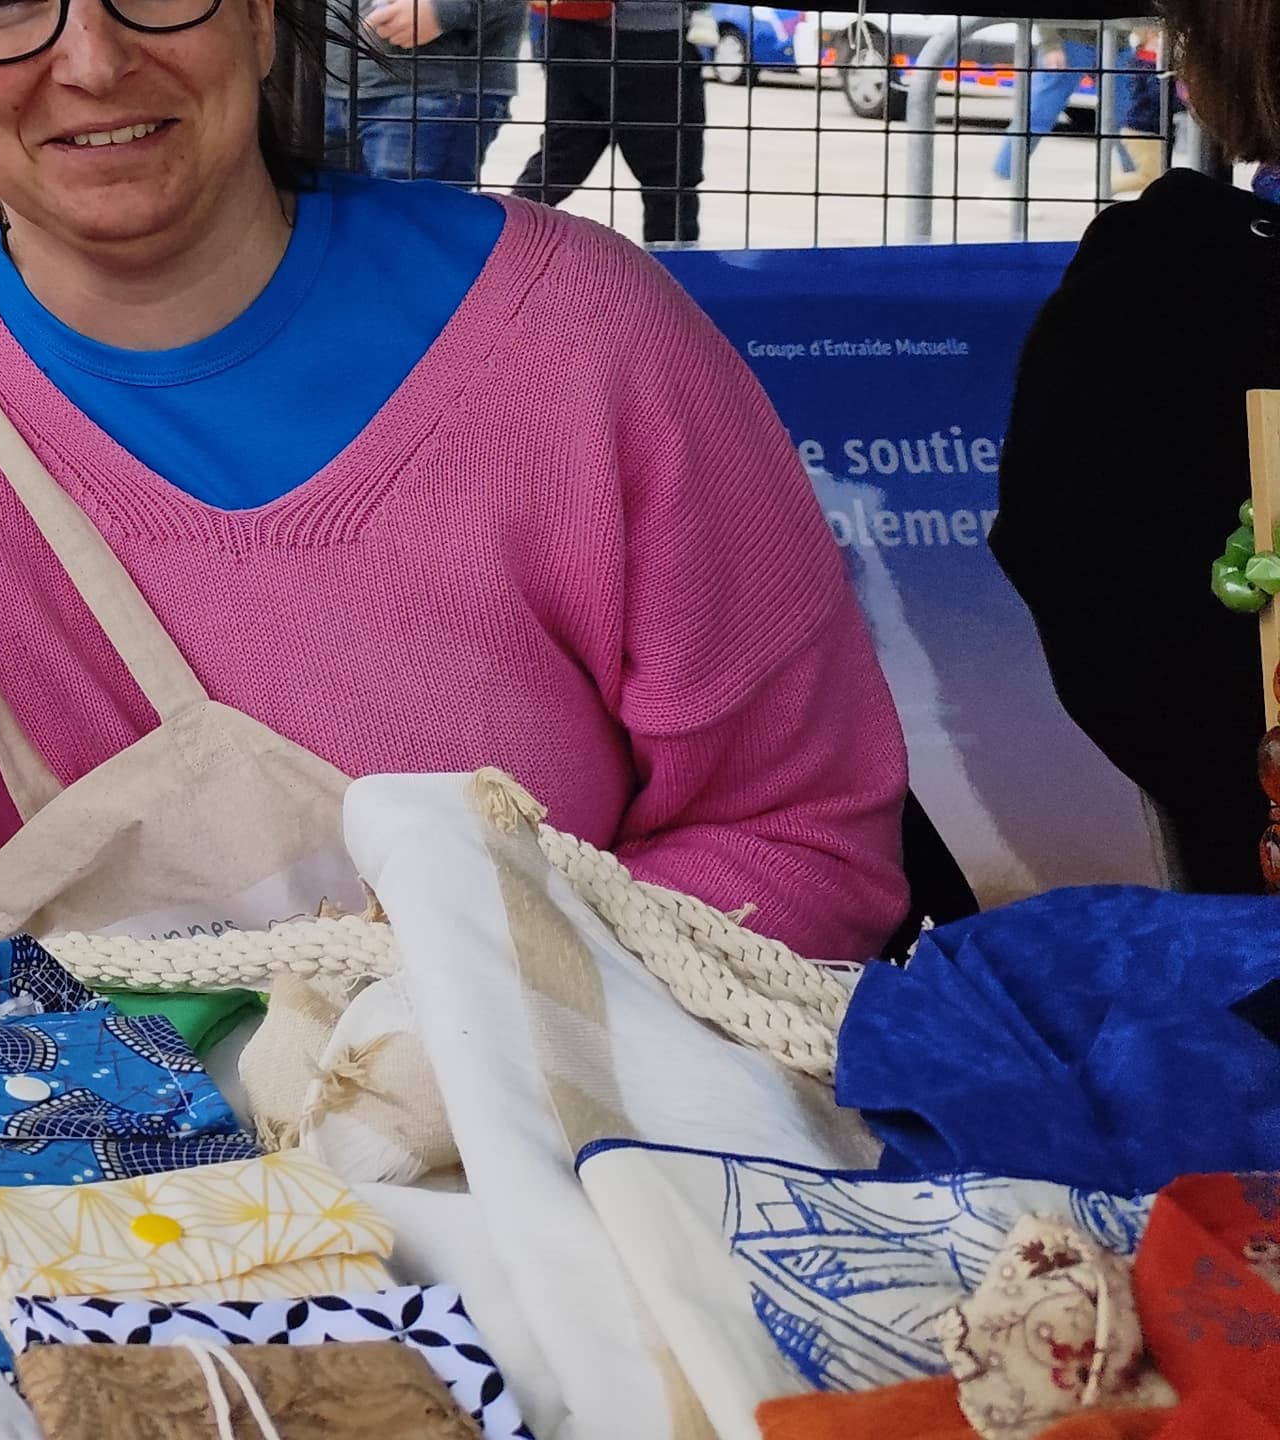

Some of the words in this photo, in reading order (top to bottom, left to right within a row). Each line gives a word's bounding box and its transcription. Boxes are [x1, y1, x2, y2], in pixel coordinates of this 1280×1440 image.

[747, 339, 806, 360] Groupe
[896, 337, 968, 357] Mutuelle
[843, 426, 1005, 475] soutie
